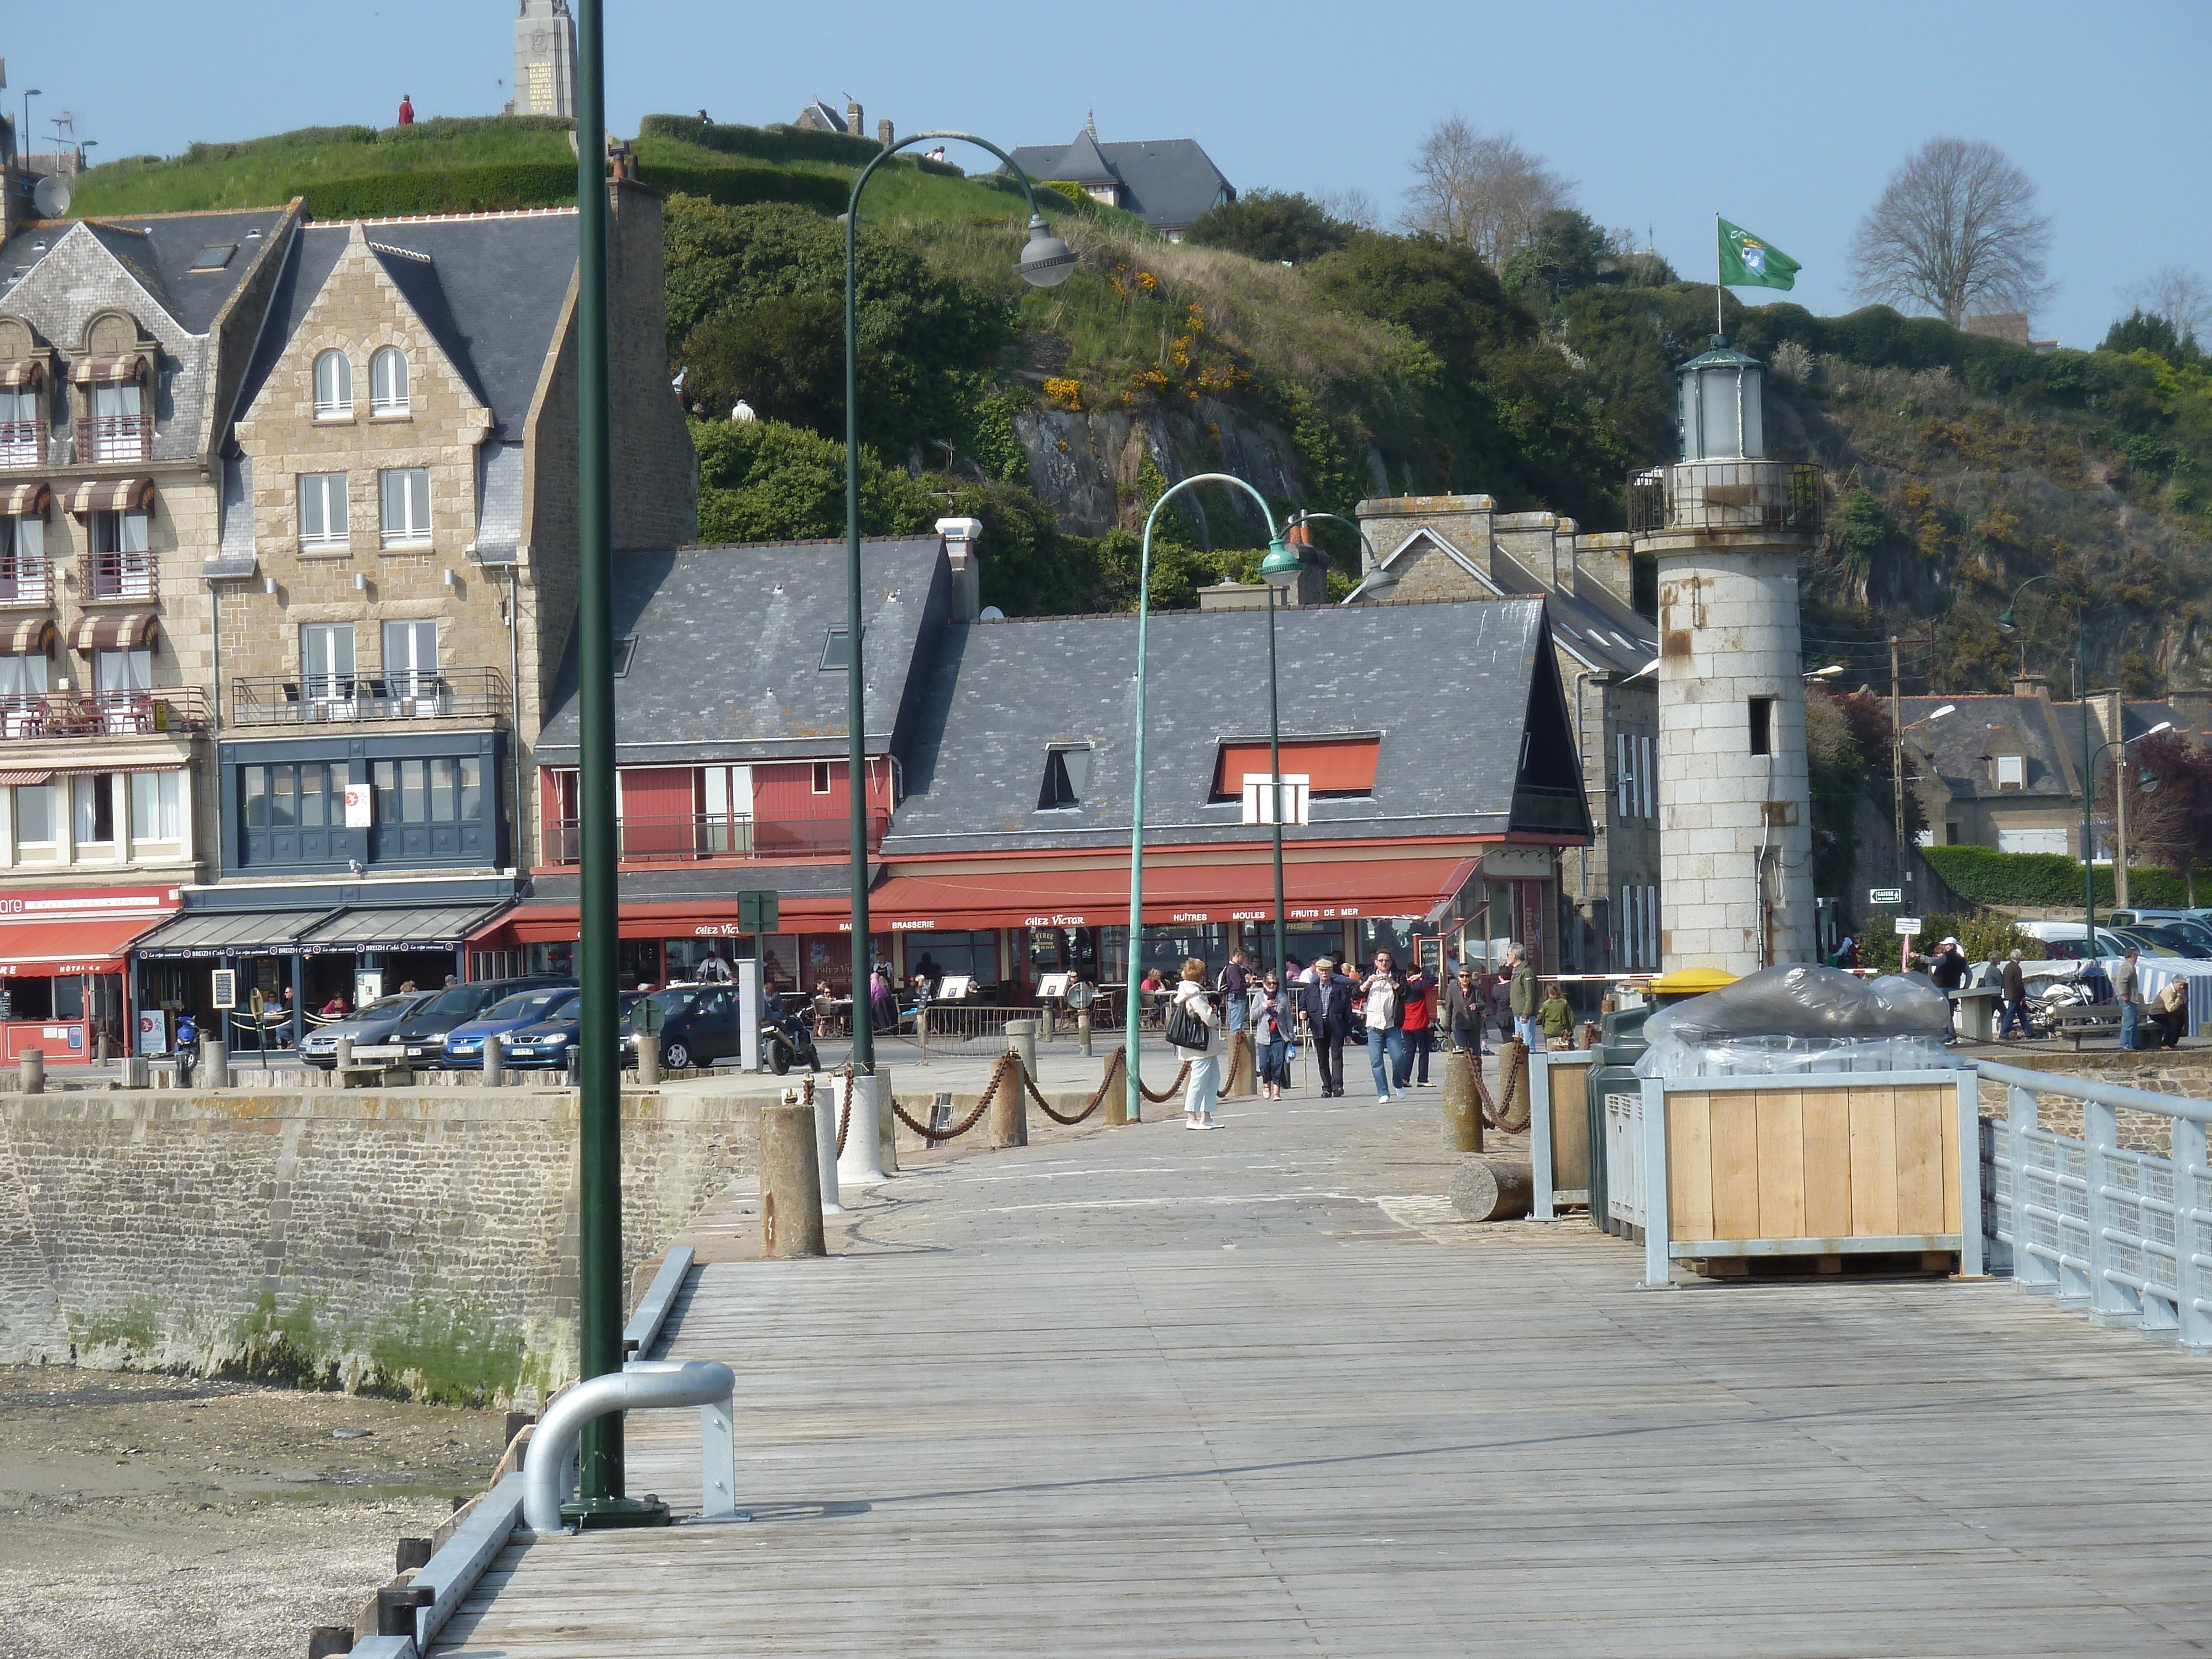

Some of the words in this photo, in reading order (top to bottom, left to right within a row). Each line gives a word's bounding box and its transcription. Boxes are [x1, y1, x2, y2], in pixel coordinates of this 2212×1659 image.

[1025, 916, 1049, 925] CHEZ
[1173, 913, 1207, 921] HUÎTRES
[892, 921, 935, 929] BRASSERIE
[695, 926, 718, 935] CHEZ
